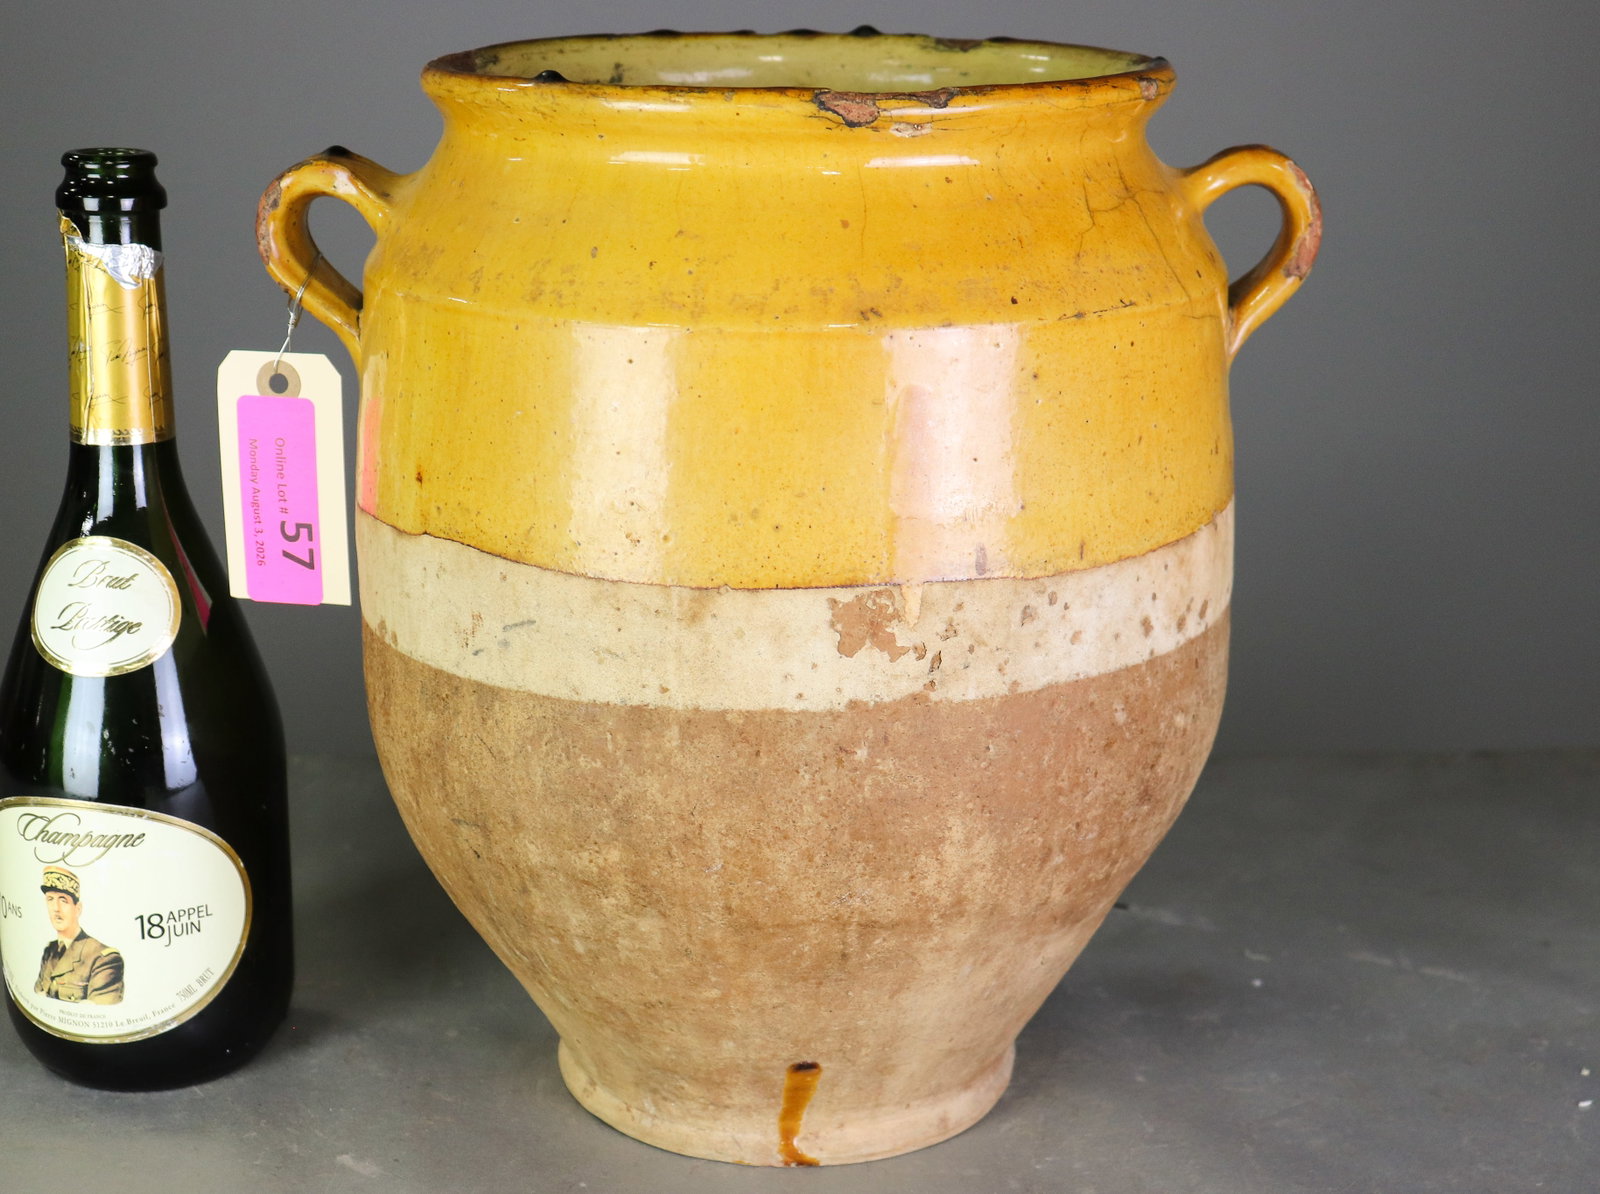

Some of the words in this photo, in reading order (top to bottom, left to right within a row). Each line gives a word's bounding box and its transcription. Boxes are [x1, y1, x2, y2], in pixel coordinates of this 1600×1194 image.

[249, 438, 261, 485] Monday
[274, 437, 287, 480] Online
[250, 487, 262, 524] August
[277, 483, 288, 503] Lot
[254, 527, 264, 537] 3,
[280, 520, 315, 571] 57
[255, 540, 267, 567] 2026
[67, 559, 140, 591] Brut
[17, 812, 147, 868] Champagne
[134, 913, 166, 940] 18
[166, 903, 213, 924] APPEL
[164, 919, 202, 947] JUIN
[196, 967, 215, 988] BRUT
[58, 1015, 90, 1029] MIGNON
[115, 1019, 125, 1028] Le
[152, 1003, 176, 1018] France
